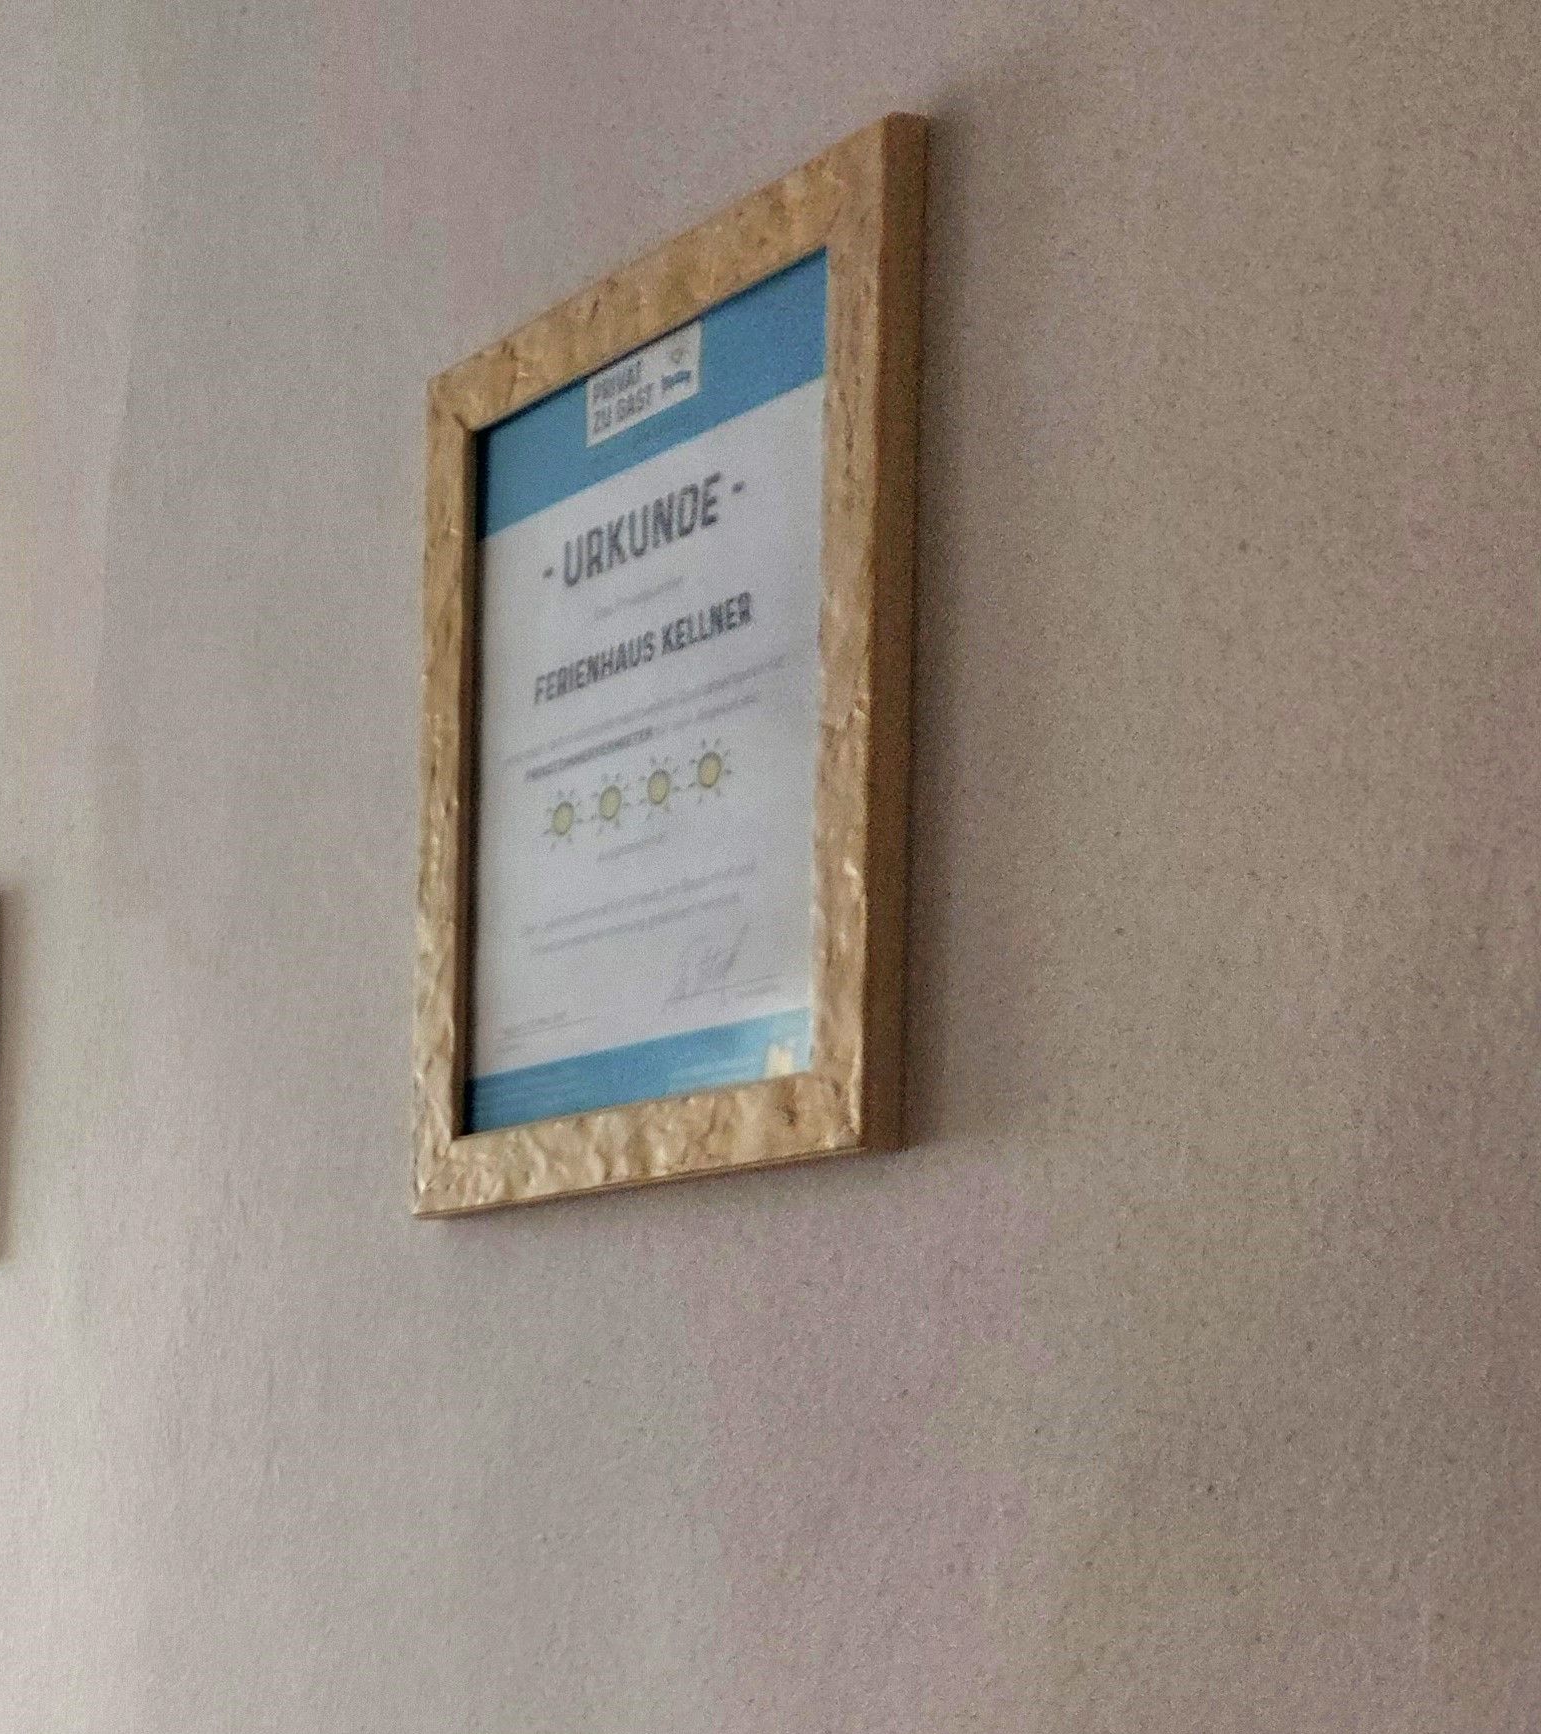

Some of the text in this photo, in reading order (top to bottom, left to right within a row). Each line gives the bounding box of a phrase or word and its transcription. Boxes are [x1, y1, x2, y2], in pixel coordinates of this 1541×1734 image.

[563, 471, 722, 587] URKUNDE
[533, 630, 656, 705] FERIENHAUS
[661, 591, 753, 656] KELLNER
